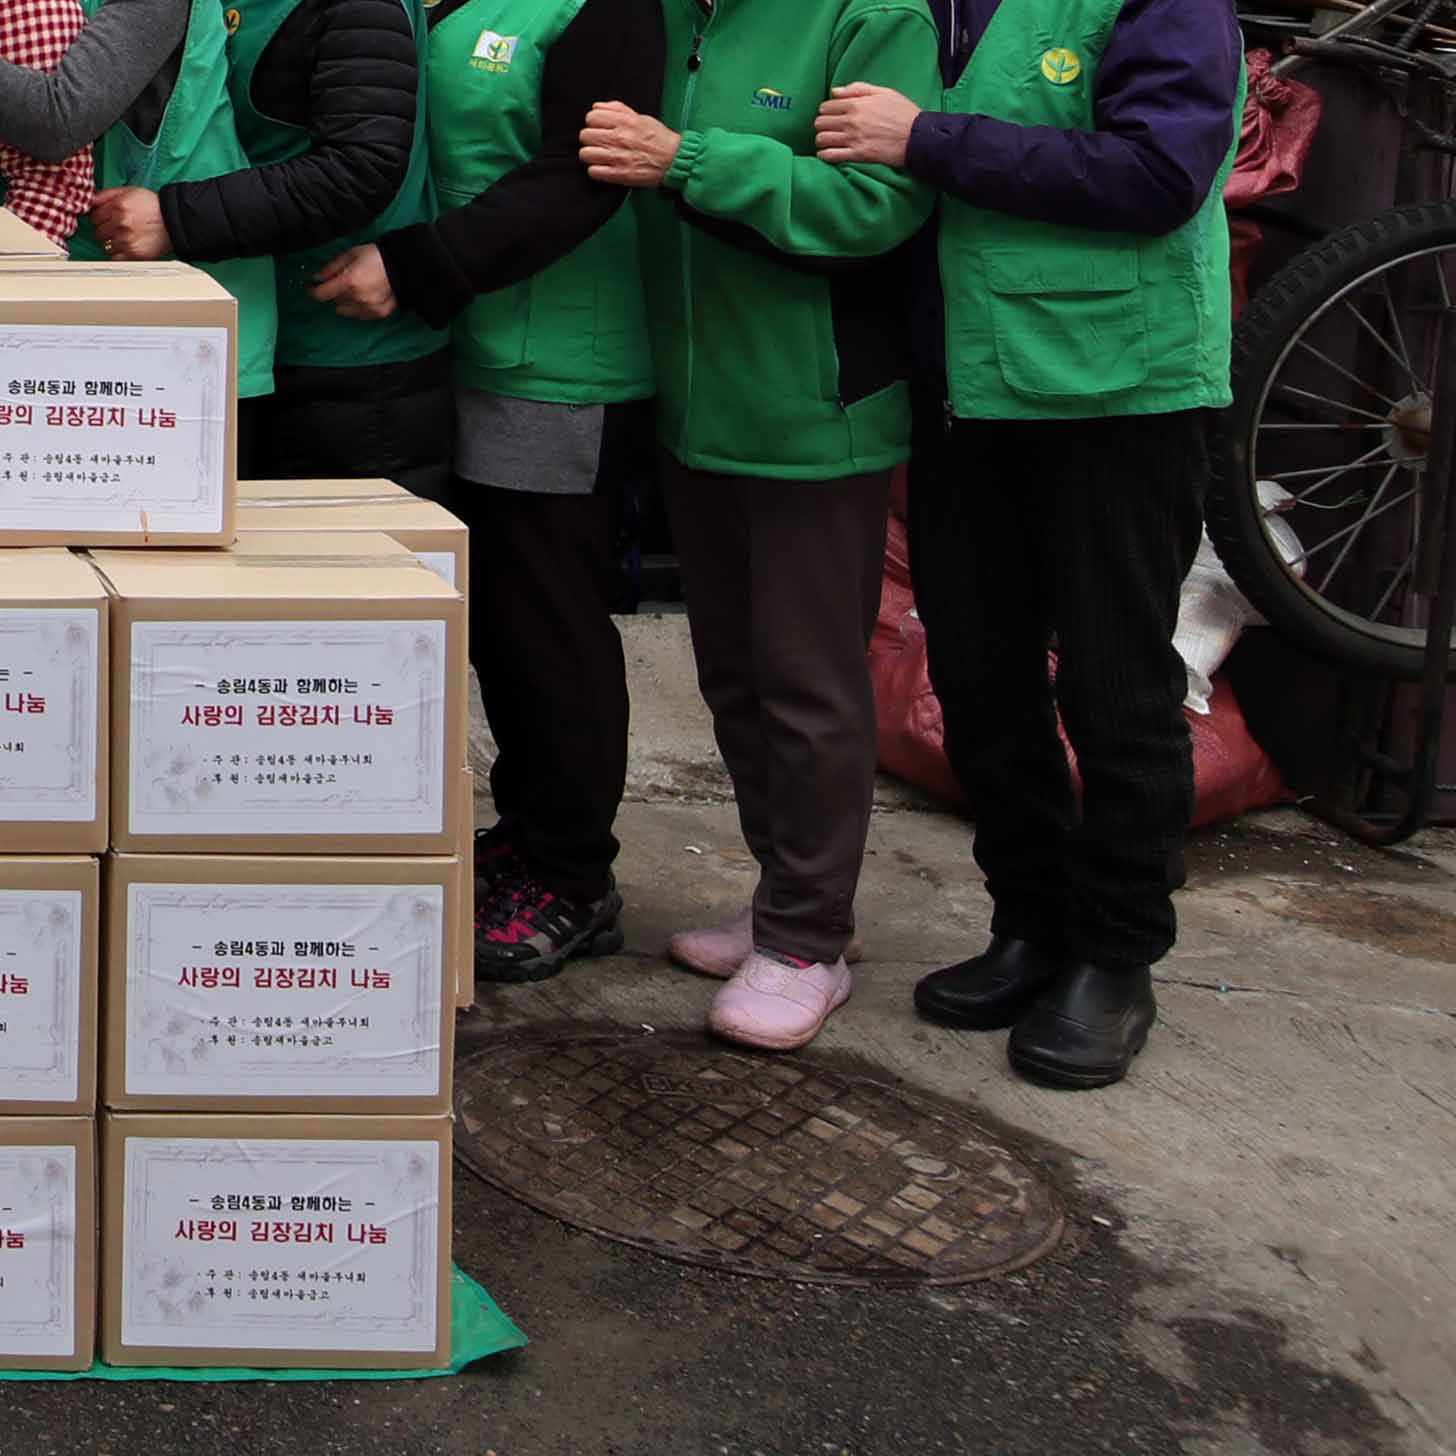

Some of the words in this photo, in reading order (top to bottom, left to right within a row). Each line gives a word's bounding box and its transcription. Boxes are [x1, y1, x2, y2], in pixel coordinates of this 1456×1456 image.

[44, 404, 126, 429] 김장김치
[137, 406, 177, 430] 나눔
[4, 691, 47, 716] 나눔
[180, 704, 244, 729] 사랑의
[255, 702, 341, 728] 김장김치
[352, 703, 395, 727] 나눔
[177, 965, 241, 990] 사랑의
[252, 966, 337, 991] 김장김치
[350, 967, 392, 991] 나눔
[174, 1218, 238, 1243] 사랑의
[249, 1219, 334, 1245] 김장김치
[346, 1221, 388, 1246] 나눔
